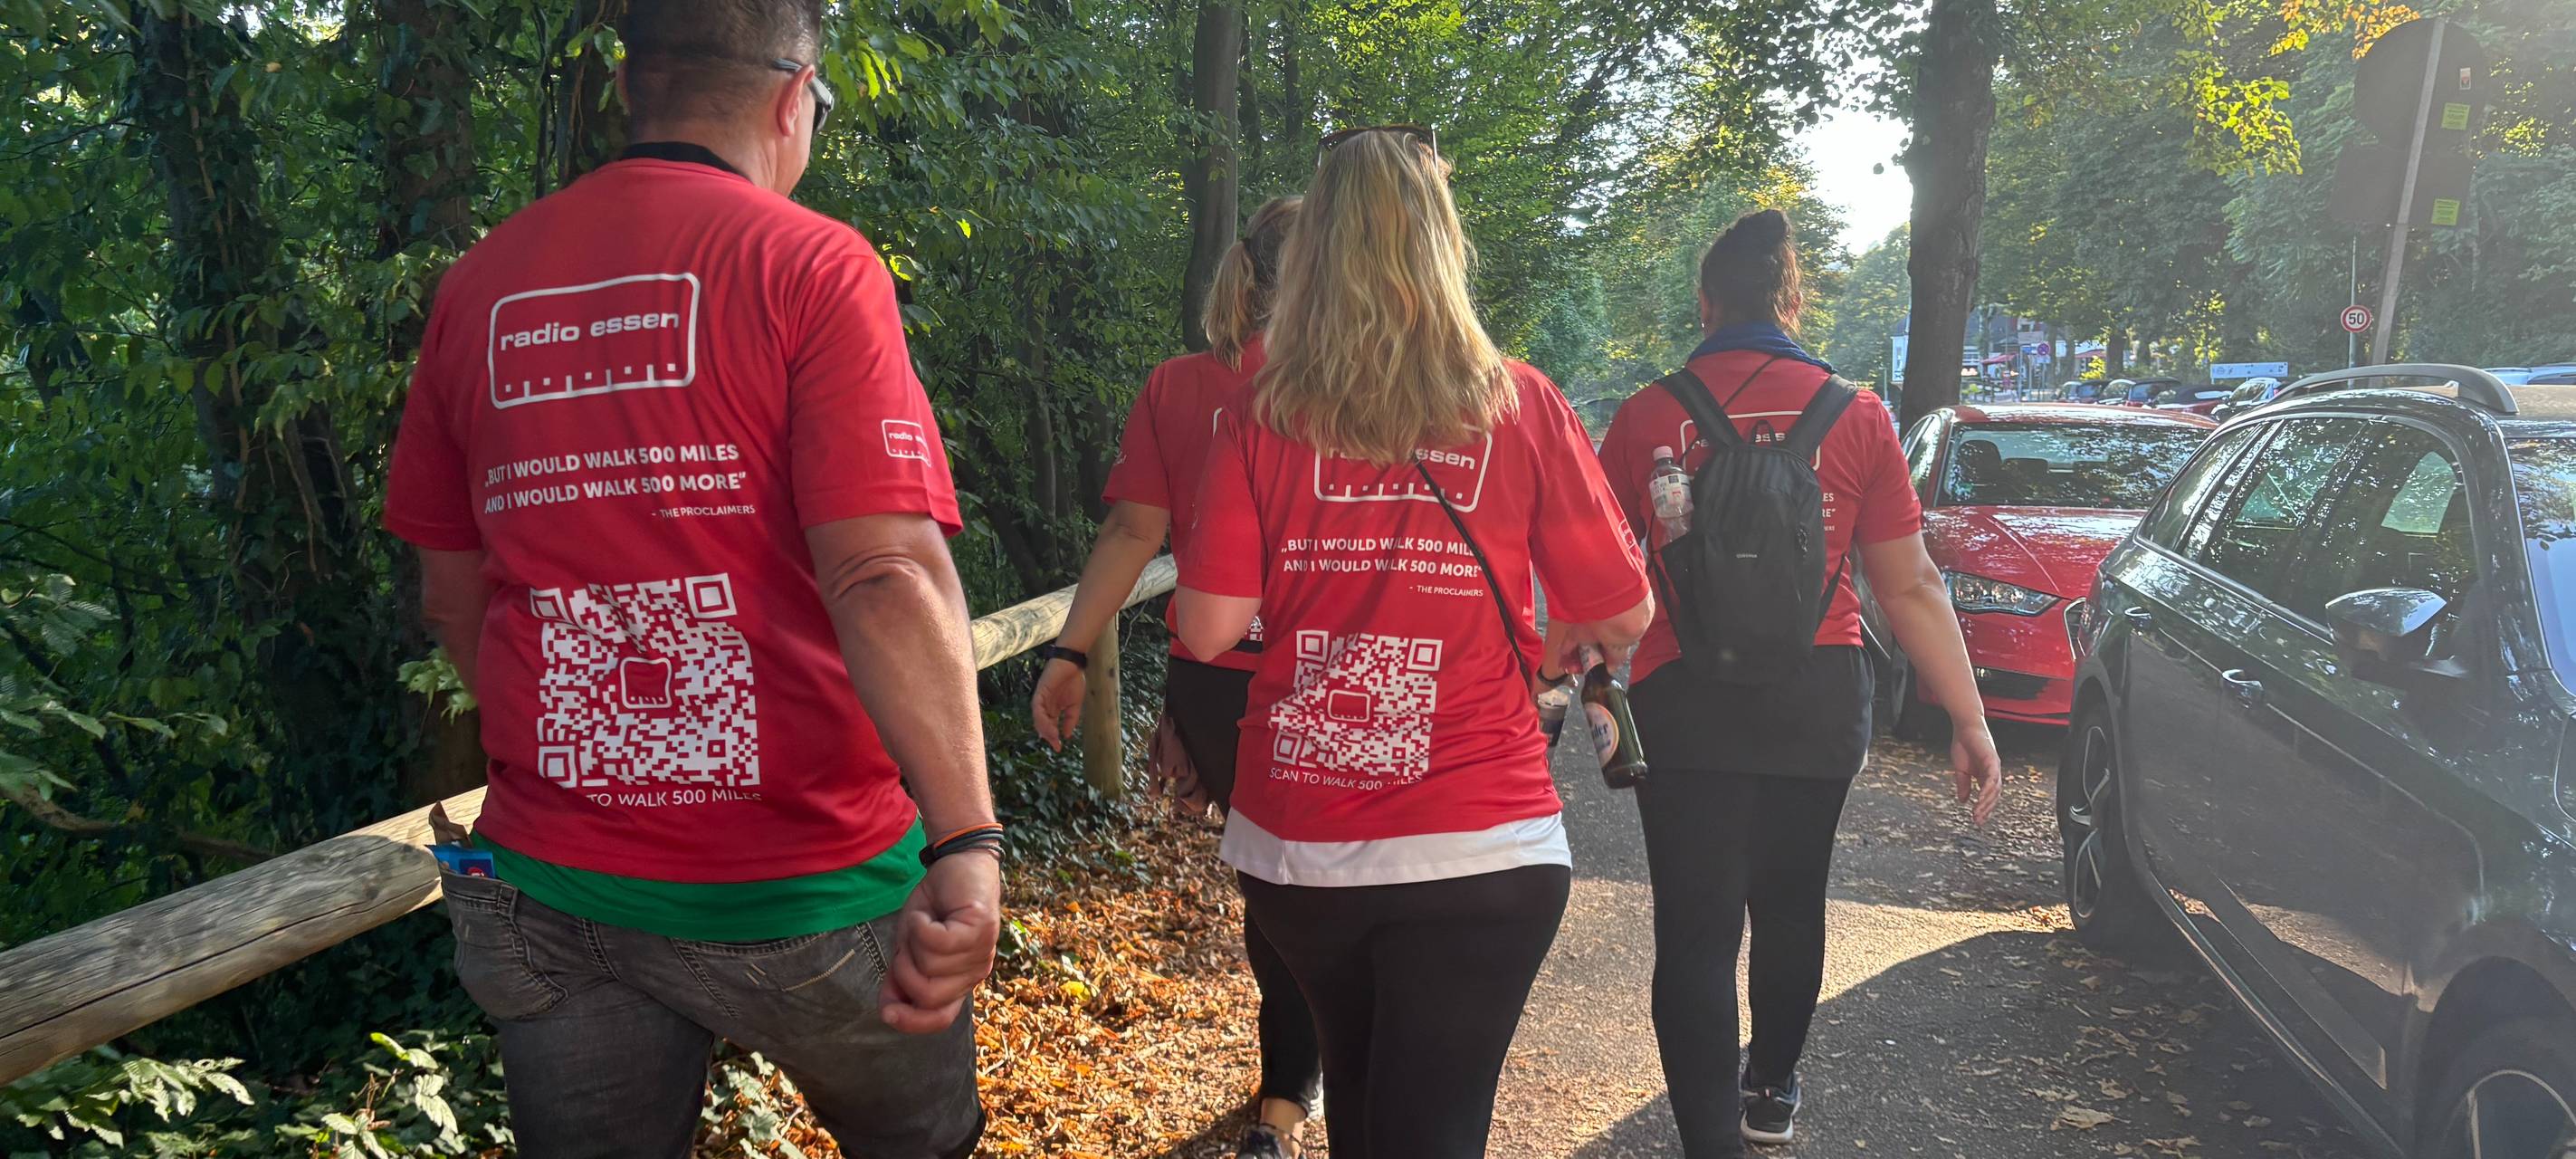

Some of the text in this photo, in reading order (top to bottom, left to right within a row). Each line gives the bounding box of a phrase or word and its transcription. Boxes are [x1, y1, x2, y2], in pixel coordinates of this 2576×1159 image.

[2348, 312, 2365, 325] 50
[501, 312, 679, 351] radio essen
[507, 464, 511, 480] I
[513, 455, 580, 478] WOULD
[583, 448, 638, 471] WALK
[639, 446, 676, 465] 500
[680, 444, 739, 463] MILES
[484, 495, 505, 514] AND
[506, 493, 512, 509] I
[513, 484, 579, 508] WOULD
[582, 478, 638, 499] WALK
[641, 475, 675, 494] 500
[660, 508, 680, 519] THE
[680, 504, 757, 517] PROCLAIMERS
[1313, 539, 1318, 551] I
[1321, 537, 1377, 551] WOULD
[1417, 539, 1444, 553] 500
[1311, 560, 1315, 572] I
[1319, 559, 1371, 572] WOULD
[1409, 560, 1437, 574] 500
[1417, 585, 1433, 594] THE
[1270, 768, 1298, 781] SCAN
[1302, 771, 1320, 784] TO
[1322, 775, 1357, 788] WALK
[1358, 780, 1383, 790] 500
[618, 791, 667, 807] WALK
[673, 789, 707, 805] 500
